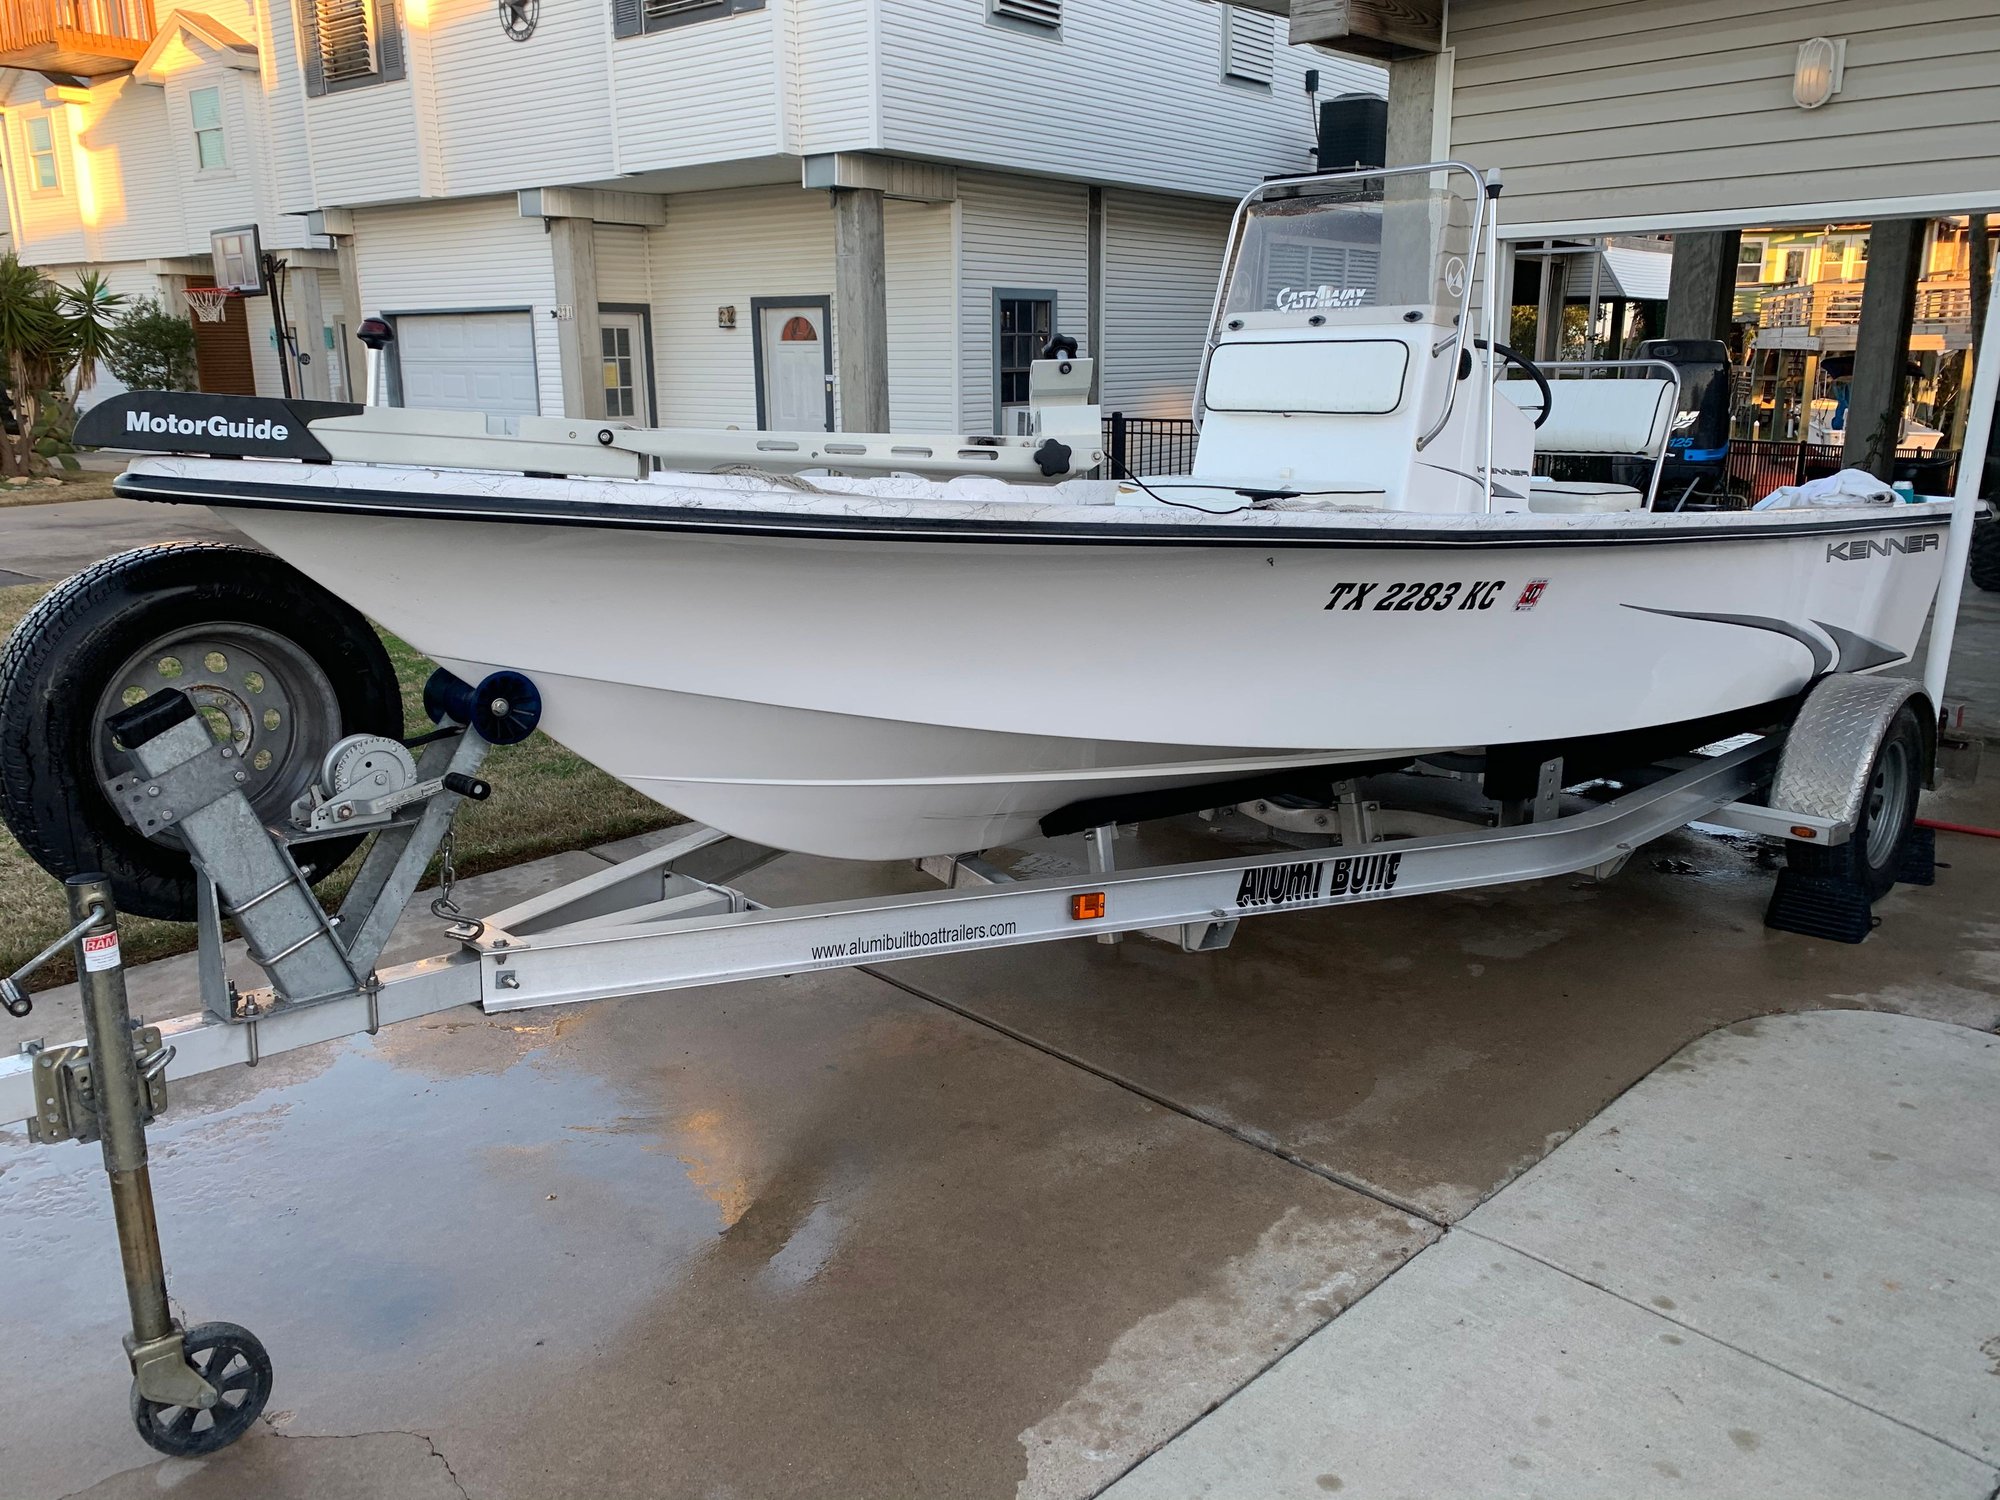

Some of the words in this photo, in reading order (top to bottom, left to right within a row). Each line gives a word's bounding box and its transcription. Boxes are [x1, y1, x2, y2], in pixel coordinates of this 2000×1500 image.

[126, 410, 289, 441] MotorGuide
[1669, 437, 1694, 448] 125
[1826, 533, 1940, 563] KENNER
[1323, 582, 1379, 611] TX
[1372, 582, 1462, 612] 2283
[1457, 580, 1506, 611] KC
[811, 921, 1016, 960] www.alumibuiltboattrailers.com
